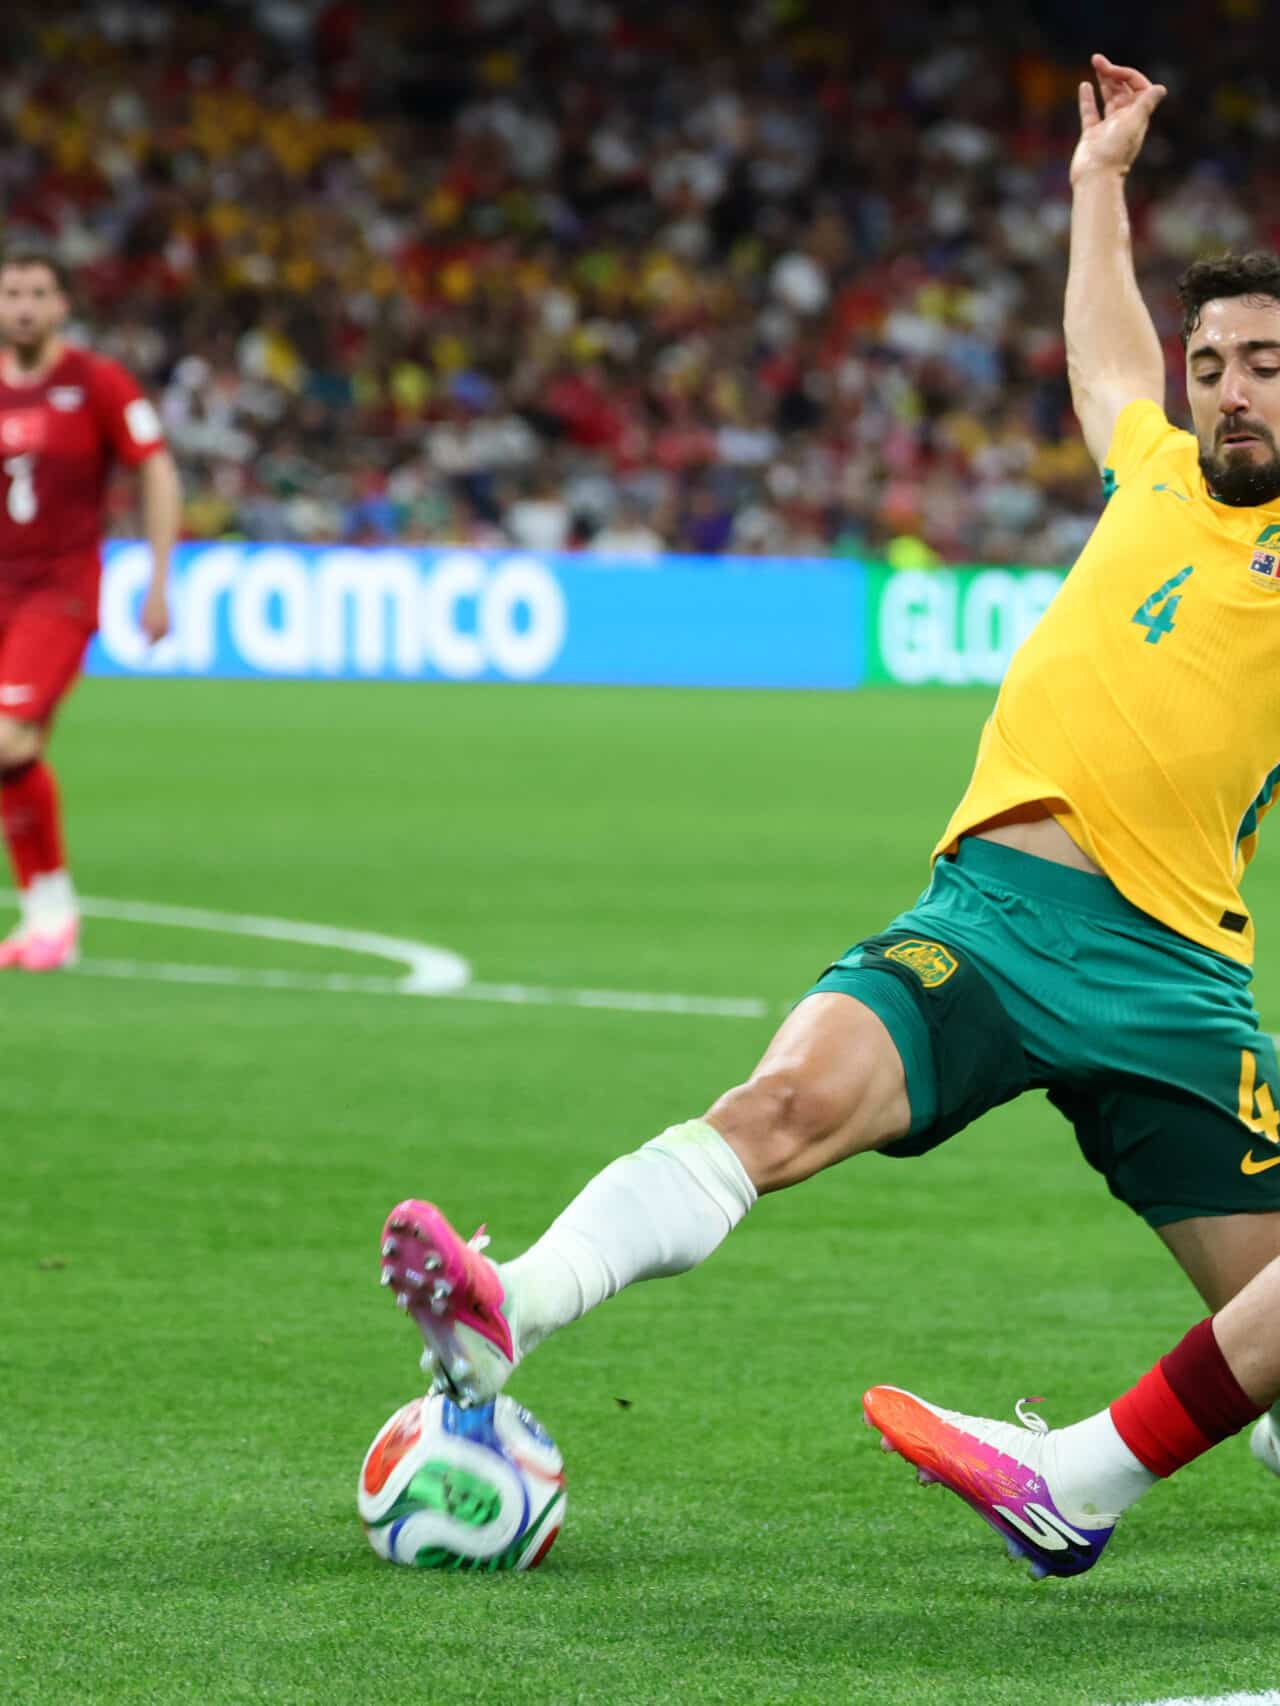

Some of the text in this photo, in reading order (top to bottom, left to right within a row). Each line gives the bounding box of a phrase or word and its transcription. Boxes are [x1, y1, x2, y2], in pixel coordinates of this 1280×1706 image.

[100, 547, 566, 678] aramco
[1131, 565, 1194, 644] 4
[1237, 1050, 1280, 1143] 4
